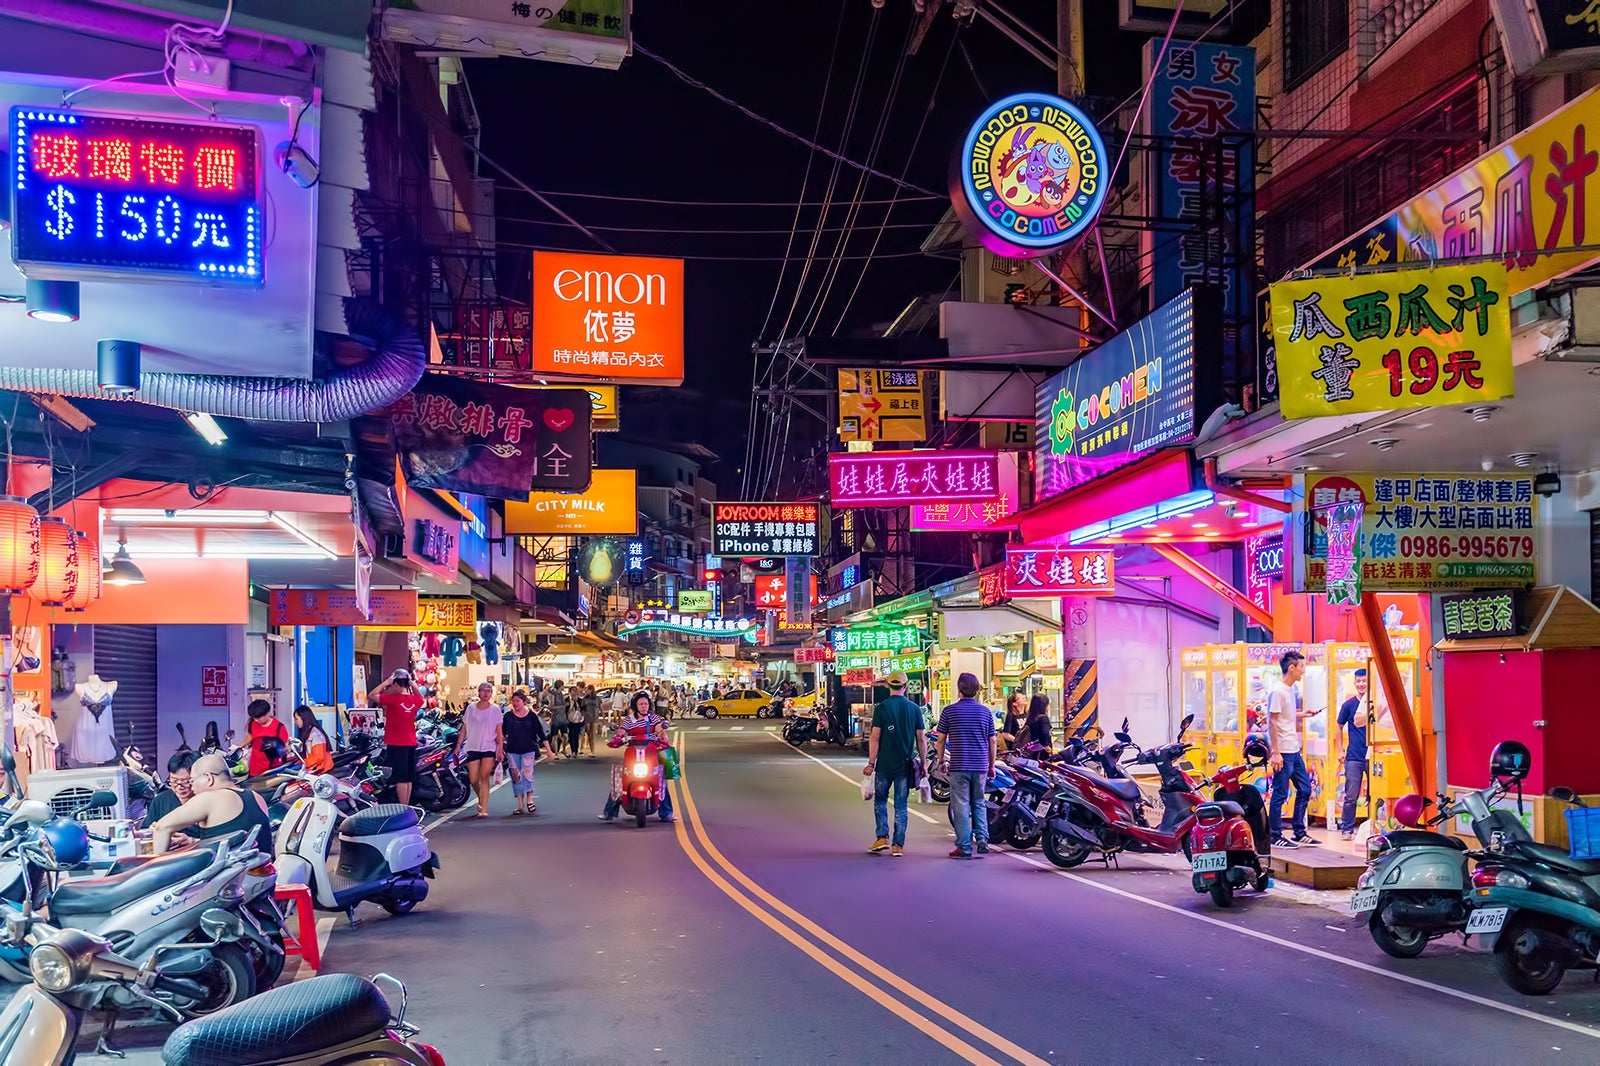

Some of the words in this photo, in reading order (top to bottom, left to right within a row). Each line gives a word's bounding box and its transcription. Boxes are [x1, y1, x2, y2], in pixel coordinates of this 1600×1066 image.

[511, 1, 621, 30] 梅の健康飲
[988, 199, 1083, 236] COCOMEN
[553, 269, 665, 305] emon
[1343, 276, 1498, 342] 西瓜汁
[584, 309, 636, 344] 依夢
[553, 349, 665, 368] 時尚精品內衣
[1382, 346, 1484, 397] 19元
[889, 399, 919, 410] 福上巷
[1076, 356, 1163, 430] COCOMEN
[1375, 478, 1532, 503] 逢甲店面/整棟套房
[535, 499, 569, 512] CITY
[571, 499, 606, 512] MILK
[716, 505, 780, 521] JOYROOM
[781, 505, 816, 521] 機樂堂
[1375, 504, 1533, 529] 大樓/大型店面出租
[717, 522, 751, 536] 3C配件
[754, 522, 816, 536] 手機專業包膜
[720, 539, 769, 552] iPhone
[772, 539, 813, 553] 專業維修
[1400, 535, 1534, 558] 0986-995679
[1016, 552, 1109, 587] 夾娃娃
[418, 602, 474, 627] 刀削麵
[1443, 594, 1513, 634] 青草苦茶
[847, 629, 917, 650] 阿宗青草茶
[1193, 857, 1226, 870] 371-TAZ
